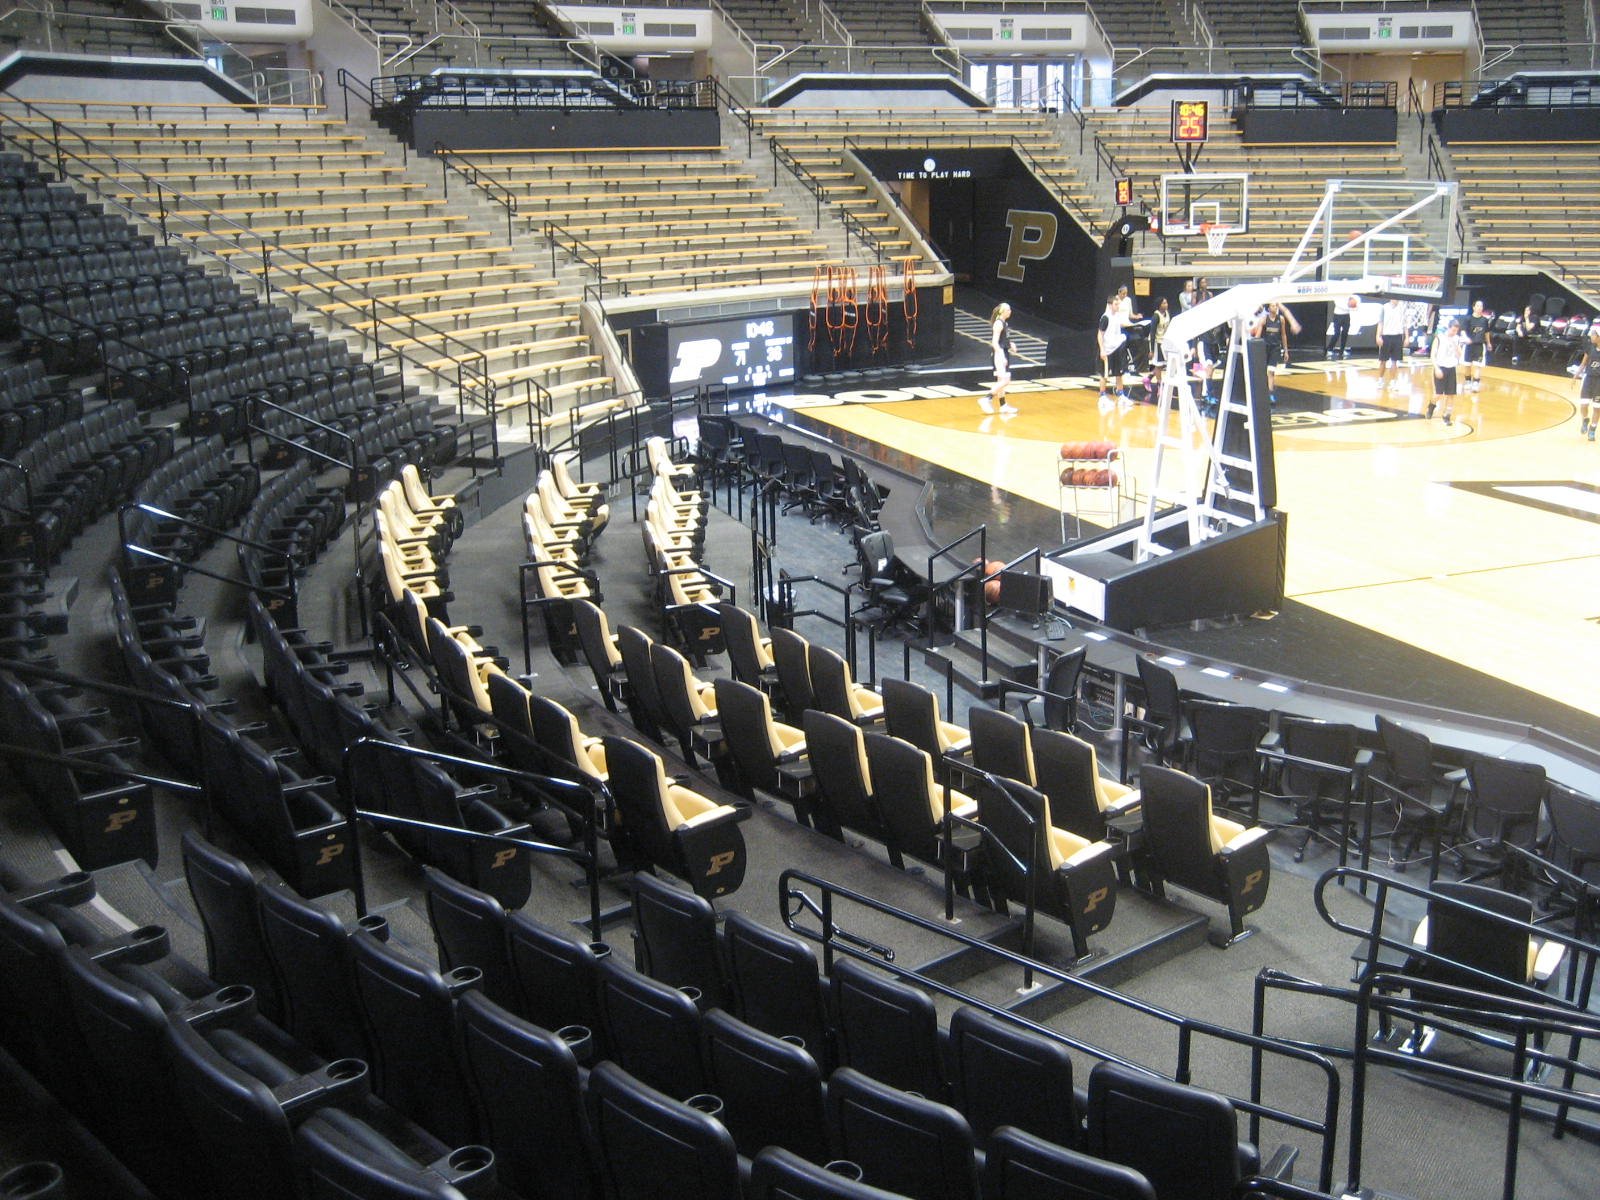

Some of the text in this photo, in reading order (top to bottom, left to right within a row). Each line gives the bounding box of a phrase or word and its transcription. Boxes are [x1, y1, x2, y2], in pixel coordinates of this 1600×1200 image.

[1180, 116, 1200, 137] 25
[931, 171, 949, 179] PLAY
[953, 170, 971, 178] HARD
[997, 209, 1058, 283] P
[669, 338, 722, 383] P
[699, 627, 721, 640] P
[105, 810, 137, 832] P
[316, 843, 344, 865] P
[491, 847, 517, 869] P
[706, 851, 735, 876] P
[1241, 870, 1263, 895] P
[1083, 886, 1108, 913] P
